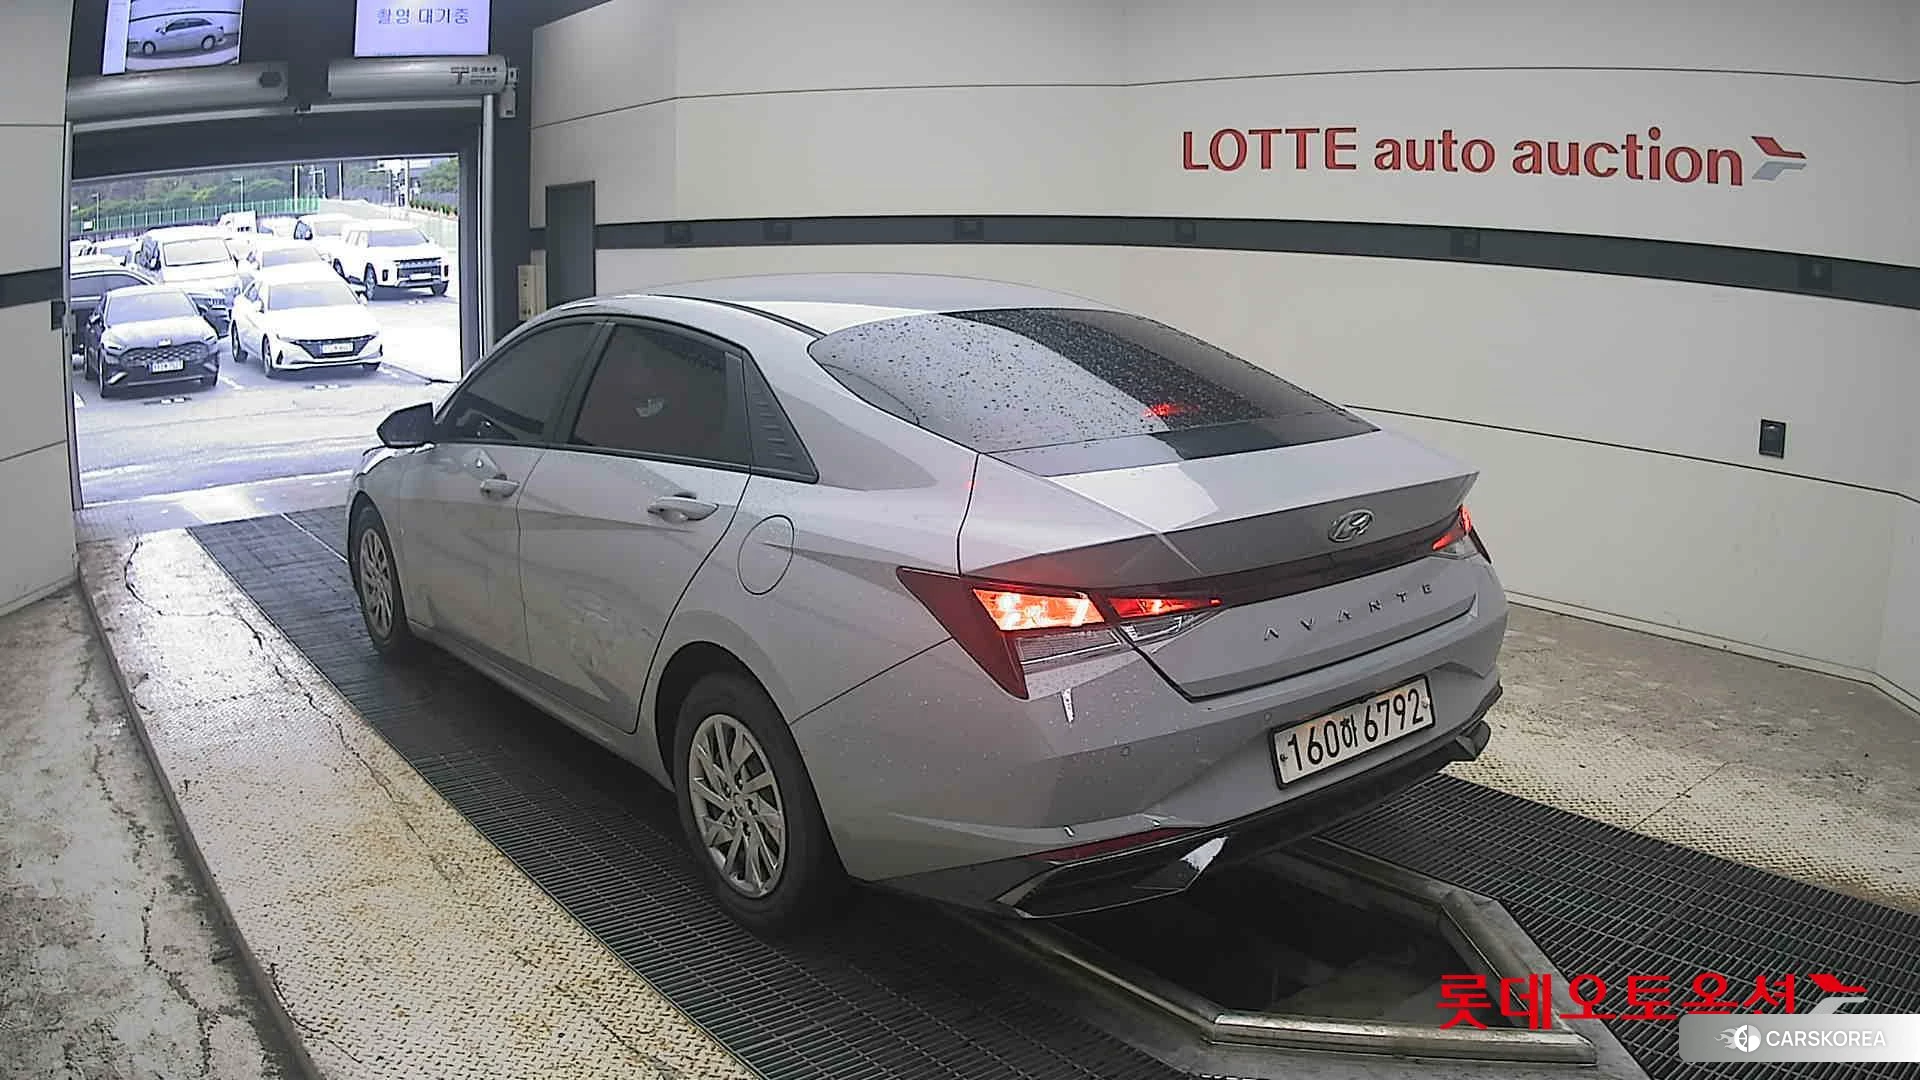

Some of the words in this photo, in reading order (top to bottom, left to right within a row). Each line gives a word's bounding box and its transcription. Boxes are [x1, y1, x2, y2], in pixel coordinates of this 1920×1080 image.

[1183, 128, 1357, 171] LOTTE
[1374, 129, 1496, 173] auto
[1512, 127, 1743, 186] auction
[1263, 583, 1433, 641] AVANTE
